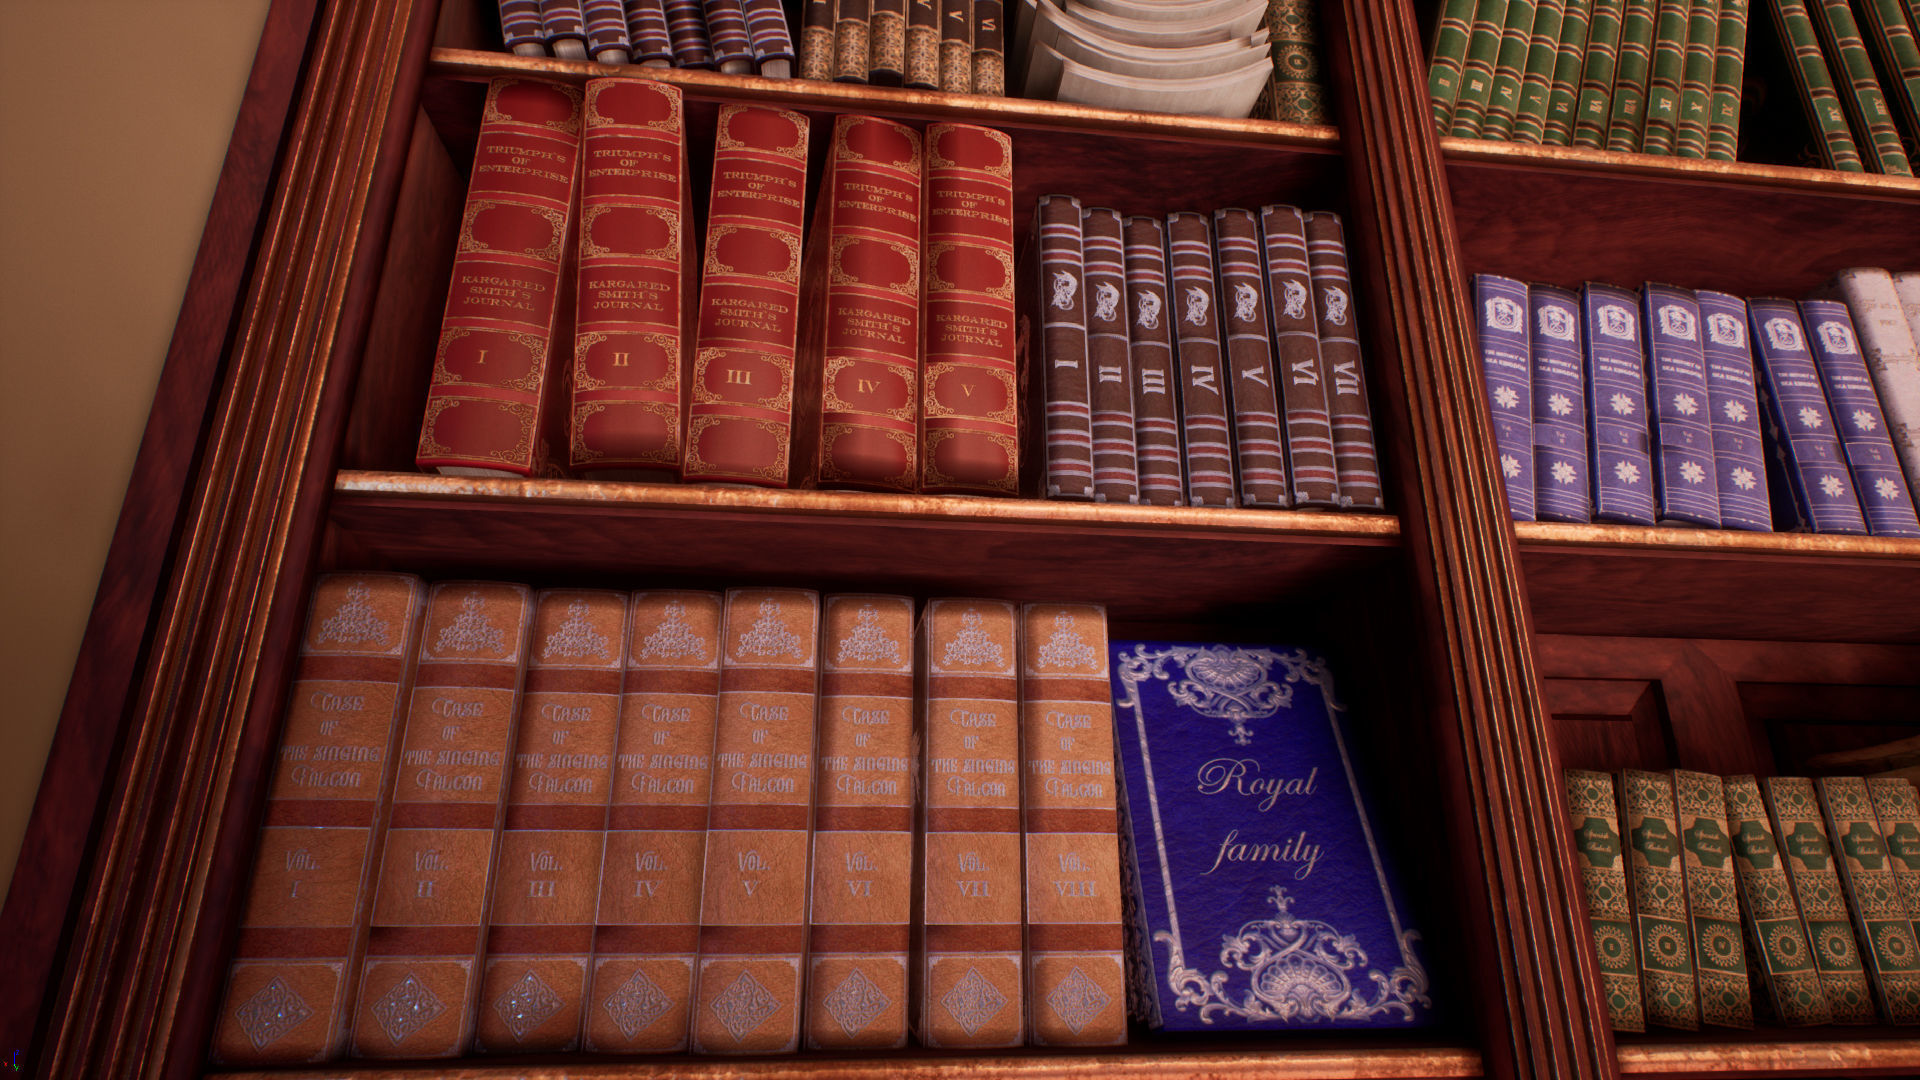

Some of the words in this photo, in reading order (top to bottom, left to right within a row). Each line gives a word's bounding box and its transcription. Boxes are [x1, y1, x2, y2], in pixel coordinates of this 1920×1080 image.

[1470, 79, 1483, 92] III
[1500, 86, 1512, 101] IV
[1556, 102, 1568, 113] VI
[1589, 100, 1603, 113] VII
[1624, 99, 1637, 115] VIII
[1660, 98, 1672, 111] IX
[1691, 102, 1703, 113] X
[1721, 104, 1734, 117] XI
[1827, 106, 1842, 121] XII
[512, 157, 530, 166] OF
[620, 158, 638, 167] OF
[479, 165, 568, 184] ENTERPRISE
[589, 169, 677, 183] ENTERPRISE
[748, 182, 764, 190] OF
[717, 190, 800, 208] ENTERPRISE
[868, 194, 885, 202] OF
[961, 200, 978, 208] OF
[838, 200, 917, 223] ENTERPRISE
[932, 208, 1010, 226] ENTERPRISE
[461, 275, 545, 292] KARGARED
[589, 280, 671, 292] KARGARED
[464, 297, 535, 311] JOURNAL
[593, 301, 664, 311] JOURNAL
[711, 298, 789, 314] KARGARED
[838, 307, 912, 326] KARGARED
[936, 314, 1008, 329] KARGARED
[714, 318, 781, 333] JOURNAL
[842, 327, 905, 344] JOURNAL
[941, 334, 1003, 348] JOURNAL
[478, 349, 488, 364] I
[612, 352, 629, 367] II
[1054, 360, 1078, 369] I
[1291, 358, 1320, 386] VI
[726, 369, 752, 385] III
[1098, 365, 1122, 383] II
[1141, 368, 1166, 395] III
[1191, 365, 1220, 396] IV
[1241, 366, 1269, 388] V
[1333, 360, 1360, 396] VII
[857, 379, 881, 394] IV
[961, 383, 976, 398] V
[319, 720, 339, 735] OF
[442, 726, 461, 741] OF
[553, 731, 570, 745] OF
[653, 731, 670, 745] OF
[752, 729, 768, 744] OF
[855, 733, 871, 747] OF
[964, 735, 979, 750] OF
[1060, 737, 1075, 751] OF
[280, 746, 309, 760] THE
[404, 750, 432, 765] THE
[516, 753, 543, 768] THE
[618, 753, 645, 769] THE
[717, 753, 744, 769] THE
[821, 756, 848, 771] THE
[930, 759, 958, 774] THE
[1028, 760, 1054, 775] THE
[1197, 758, 1318, 812] Royal
[1200, 829, 1324, 880] family
[290, 880, 301, 898] I
[416, 880, 436, 897] II
[526, 880, 555, 897] III
[632, 880, 663, 897] IV
[742, 880, 759, 896] V
[847, 880, 873, 897] VI
[956, 880, 990, 897] VII
[1053, 880, 1097, 898] VIII
